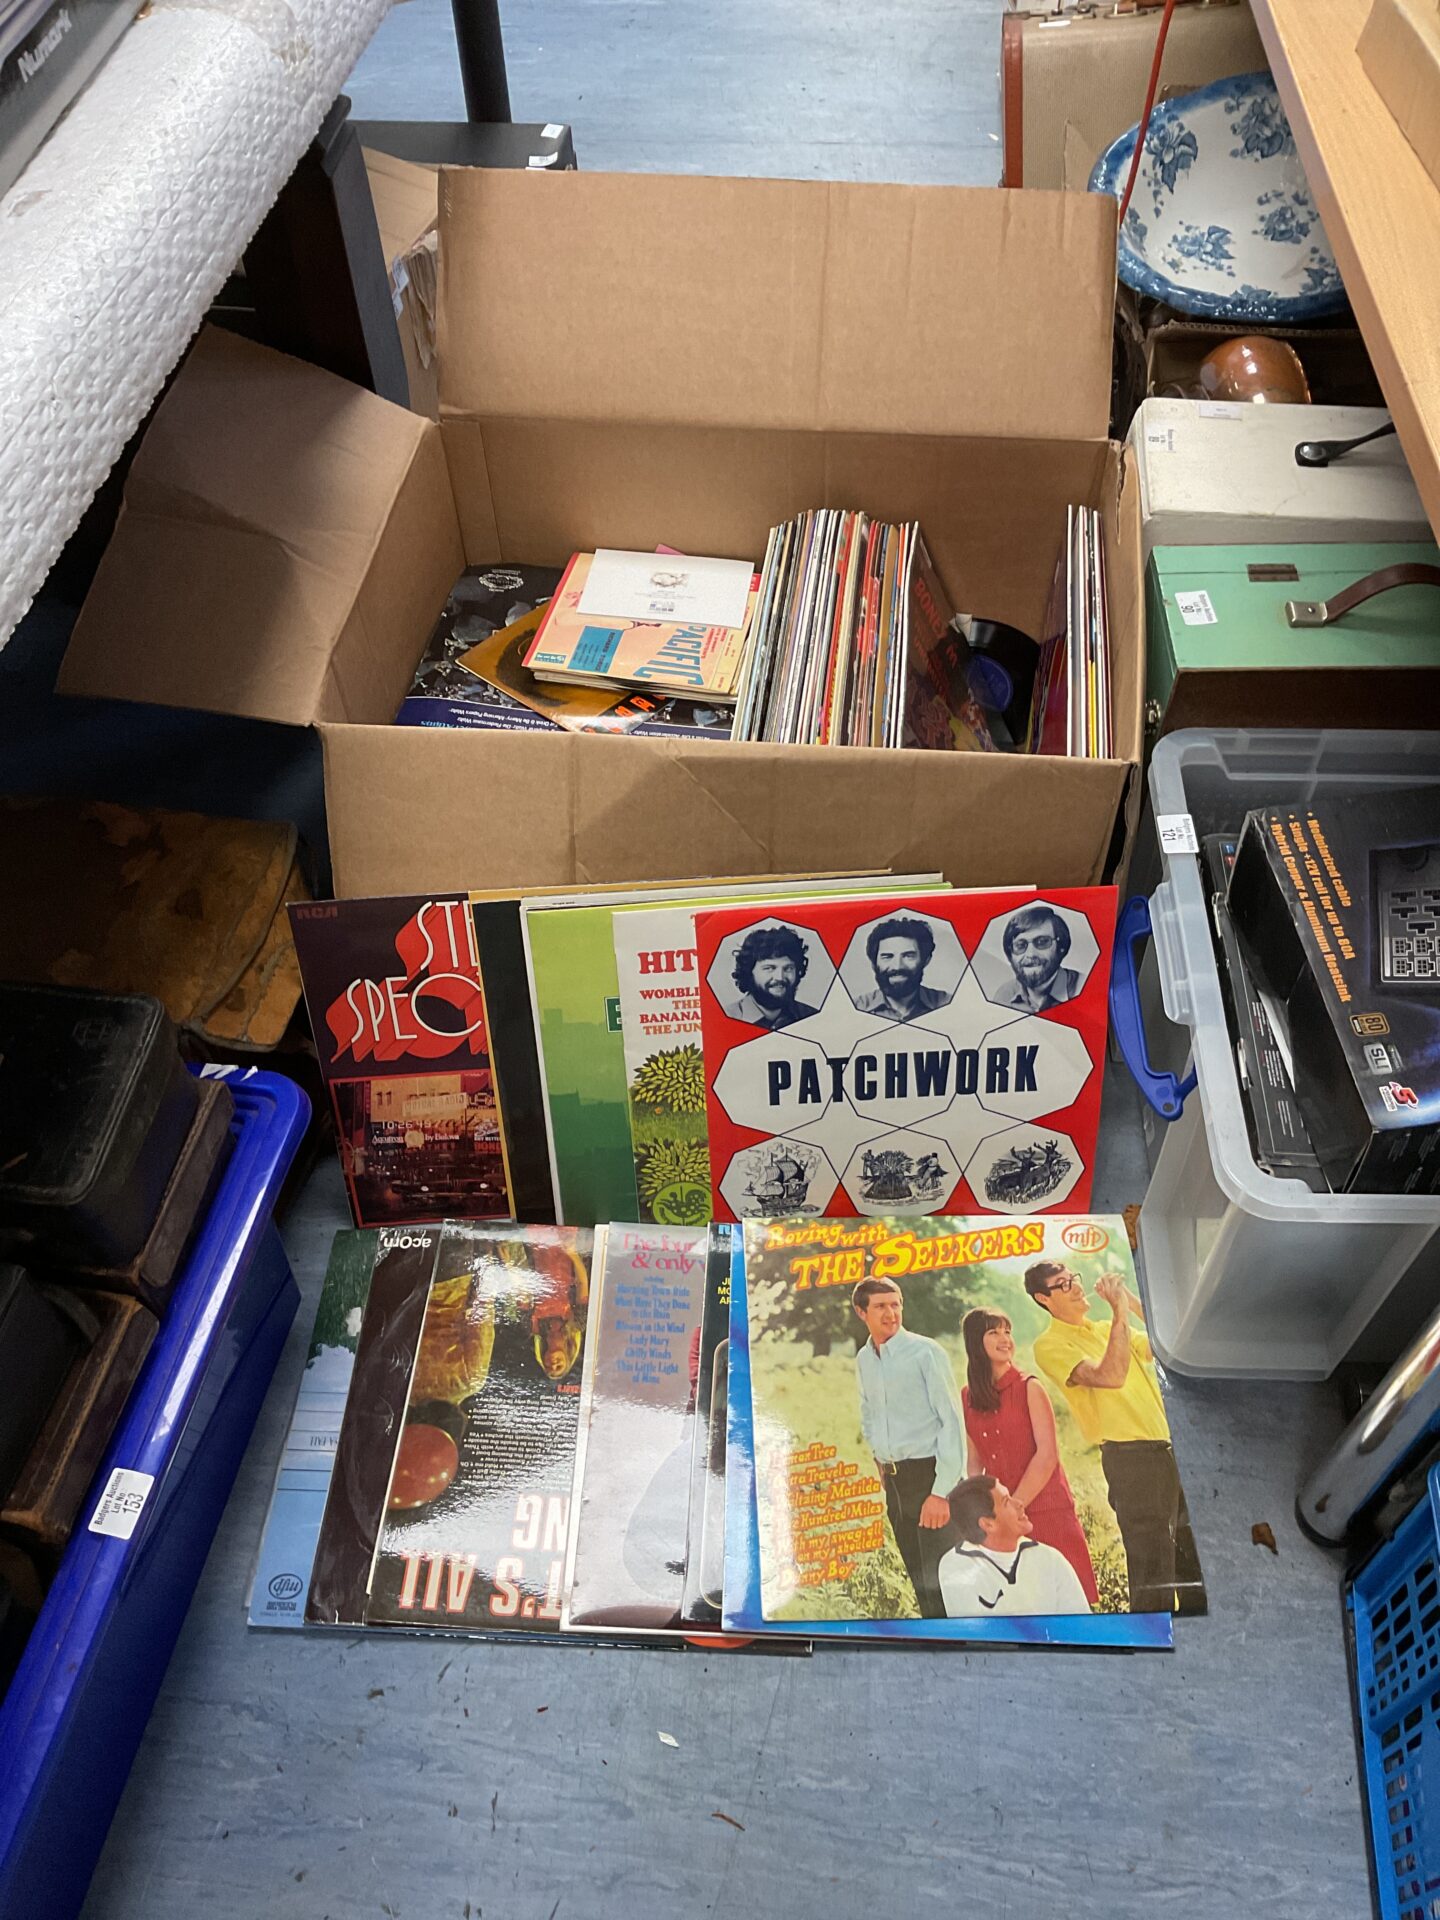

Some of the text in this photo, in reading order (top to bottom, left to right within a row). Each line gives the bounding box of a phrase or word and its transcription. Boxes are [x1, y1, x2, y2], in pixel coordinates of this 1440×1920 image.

[17, 8, 72, 83] Numark
[914, 577, 948, 638] BONEY
[633, 624, 707, 686] PACIFIC
[1162, 828, 1176, 841] 121
[1289, 821, 1308, 853] Single
[1304, 853, 1321, 876] +12V
[1307, 819, 1351, 908] Modularized cable
[1311, 876, 1328, 895] rail
[1320, 895, 1333, 911] for
[1270, 823, 1292, 855] Hybrid
[1283, 856, 1305, 890] Copper
[1302, 900, 1331, 952] Aluminum
[1323, 953, 1352, 1002] Heatsink
[1326, 911, 1340, 927] up
[1332, 926, 1344, 937] to
[346, 972, 482, 1043] SPEC
[672, 999, 701, 1010] THE
[639, 1011, 702, 1024] BANANA
[1365, 1017, 1384, 1031] 80
[643, 1024, 672, 1035] THE
[1371, 1048, 1389, 1069] SLI
[767, 1044, 1039, 1106] PATCHWORK
[768, 1223, 889, 1249] Roving with
[1067, 1229, 1101, 1251] mfp
[631, 1252, 697, 1274] & only
[790, 1222, 1046, 1289] THE SEEKERS
[616, 1284, 690, 1297] Morning Town Ride
[653, 1297, 671, 1310] They
[672, 1298, 690, 1310] Done
[640, 1310, 650, 1318] the
[653, 1310, 670, 1319] Rain
[654, 1321, 665, 1331] the
[666, 1322, 685, 1333] Wind
[630, 1334, 669, 1346] Lady Mary
[625, 1347, 671, 1359] Chilly Winds
[616, 1360, 678, 1374] This Little Light
[632, 1374, 639, 1383] of
[810, 1443, 837, 1461] Tree
[806, 1462, 843, 1482] Travel
[843, 1464, 858, 1476] on
[829, 1477, 881, 1499] Matilda
[94, 1472, 124, 1525] Badgers Auctions
[122, 1493, 144, 1514] 153
[111, 1503, 121, 1513] Lot
[800, 1505, 848, 1528] Hundred
[849, 1501, 883, 1518] Miles
[866, 1521, 884, 1537] all
[836, 1536, 884, 1554] shoulder
[827, 1561, 856, 1578] Boy
[398, 1553, 476, 1613] ALL
